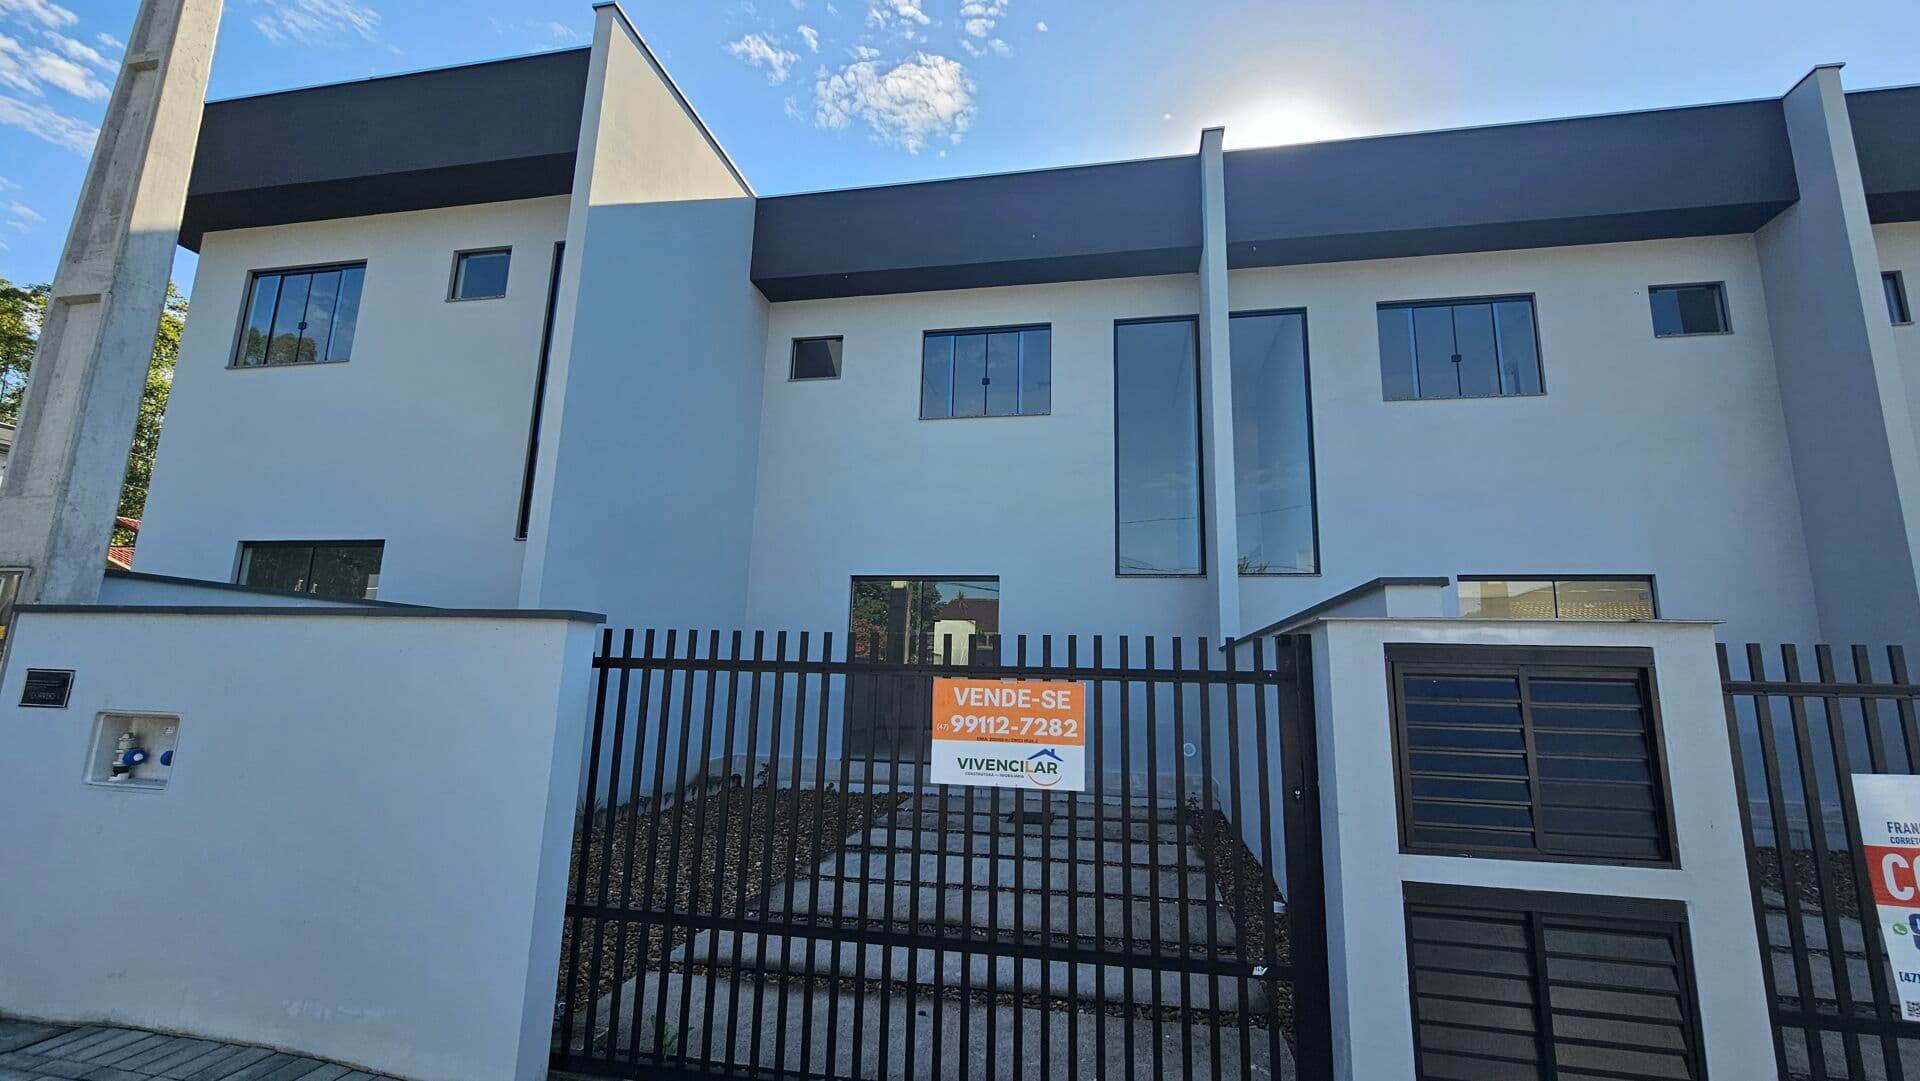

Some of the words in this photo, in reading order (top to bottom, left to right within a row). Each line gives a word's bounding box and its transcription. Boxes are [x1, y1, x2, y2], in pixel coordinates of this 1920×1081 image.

[953, 687, 1071, 709] VENDE-SE
[936, 722, 949, 731] (47)
[950, 714, 1078, 737] 99112-7282
[957, 757, 1058, 774] VIVENCILAR
[1886, 821, 1920, 834] FRAN
[1890, 836, 1920, 845] CORRET
[1882, 853, 1920, 900] C
